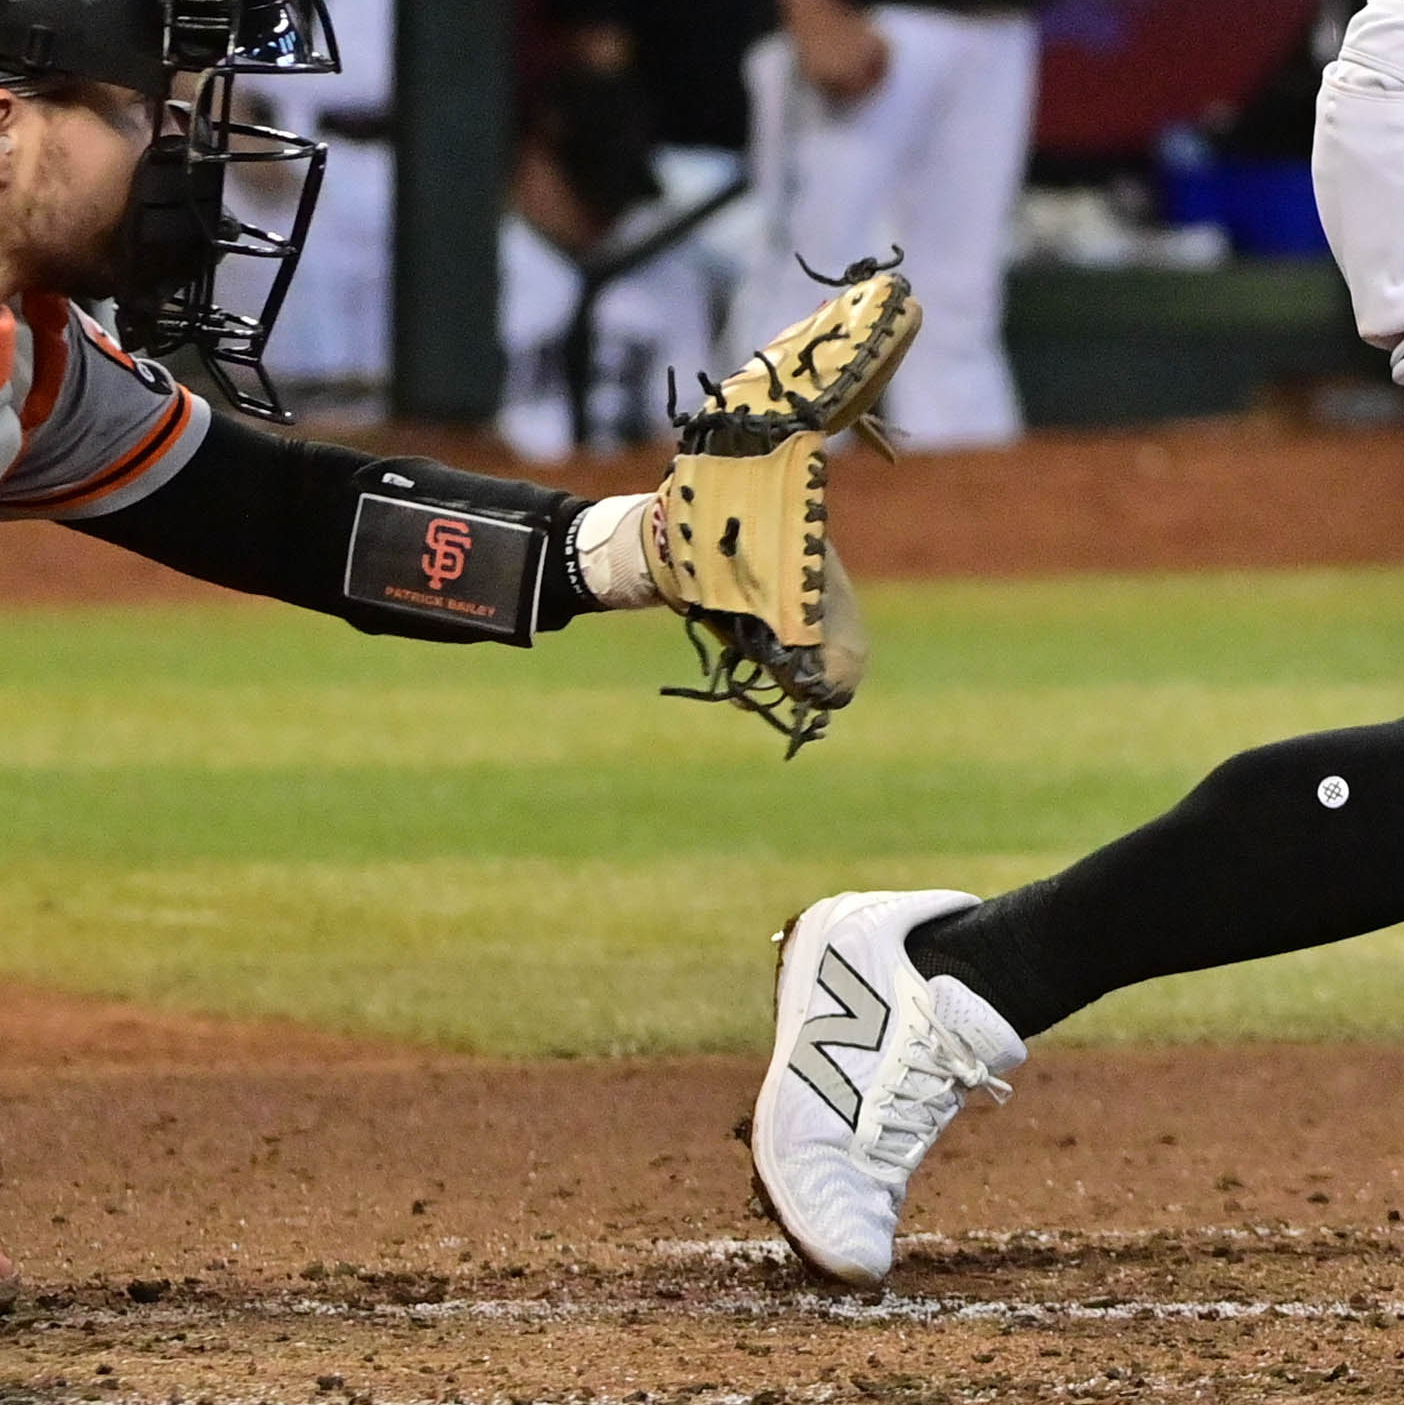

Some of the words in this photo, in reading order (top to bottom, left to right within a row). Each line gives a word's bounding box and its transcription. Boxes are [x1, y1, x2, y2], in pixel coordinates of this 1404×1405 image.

[421, 517, 473, 590] SF
[384, 586, 444, 607] PATRICK
[447, 598, 496, 619] BAILEY
